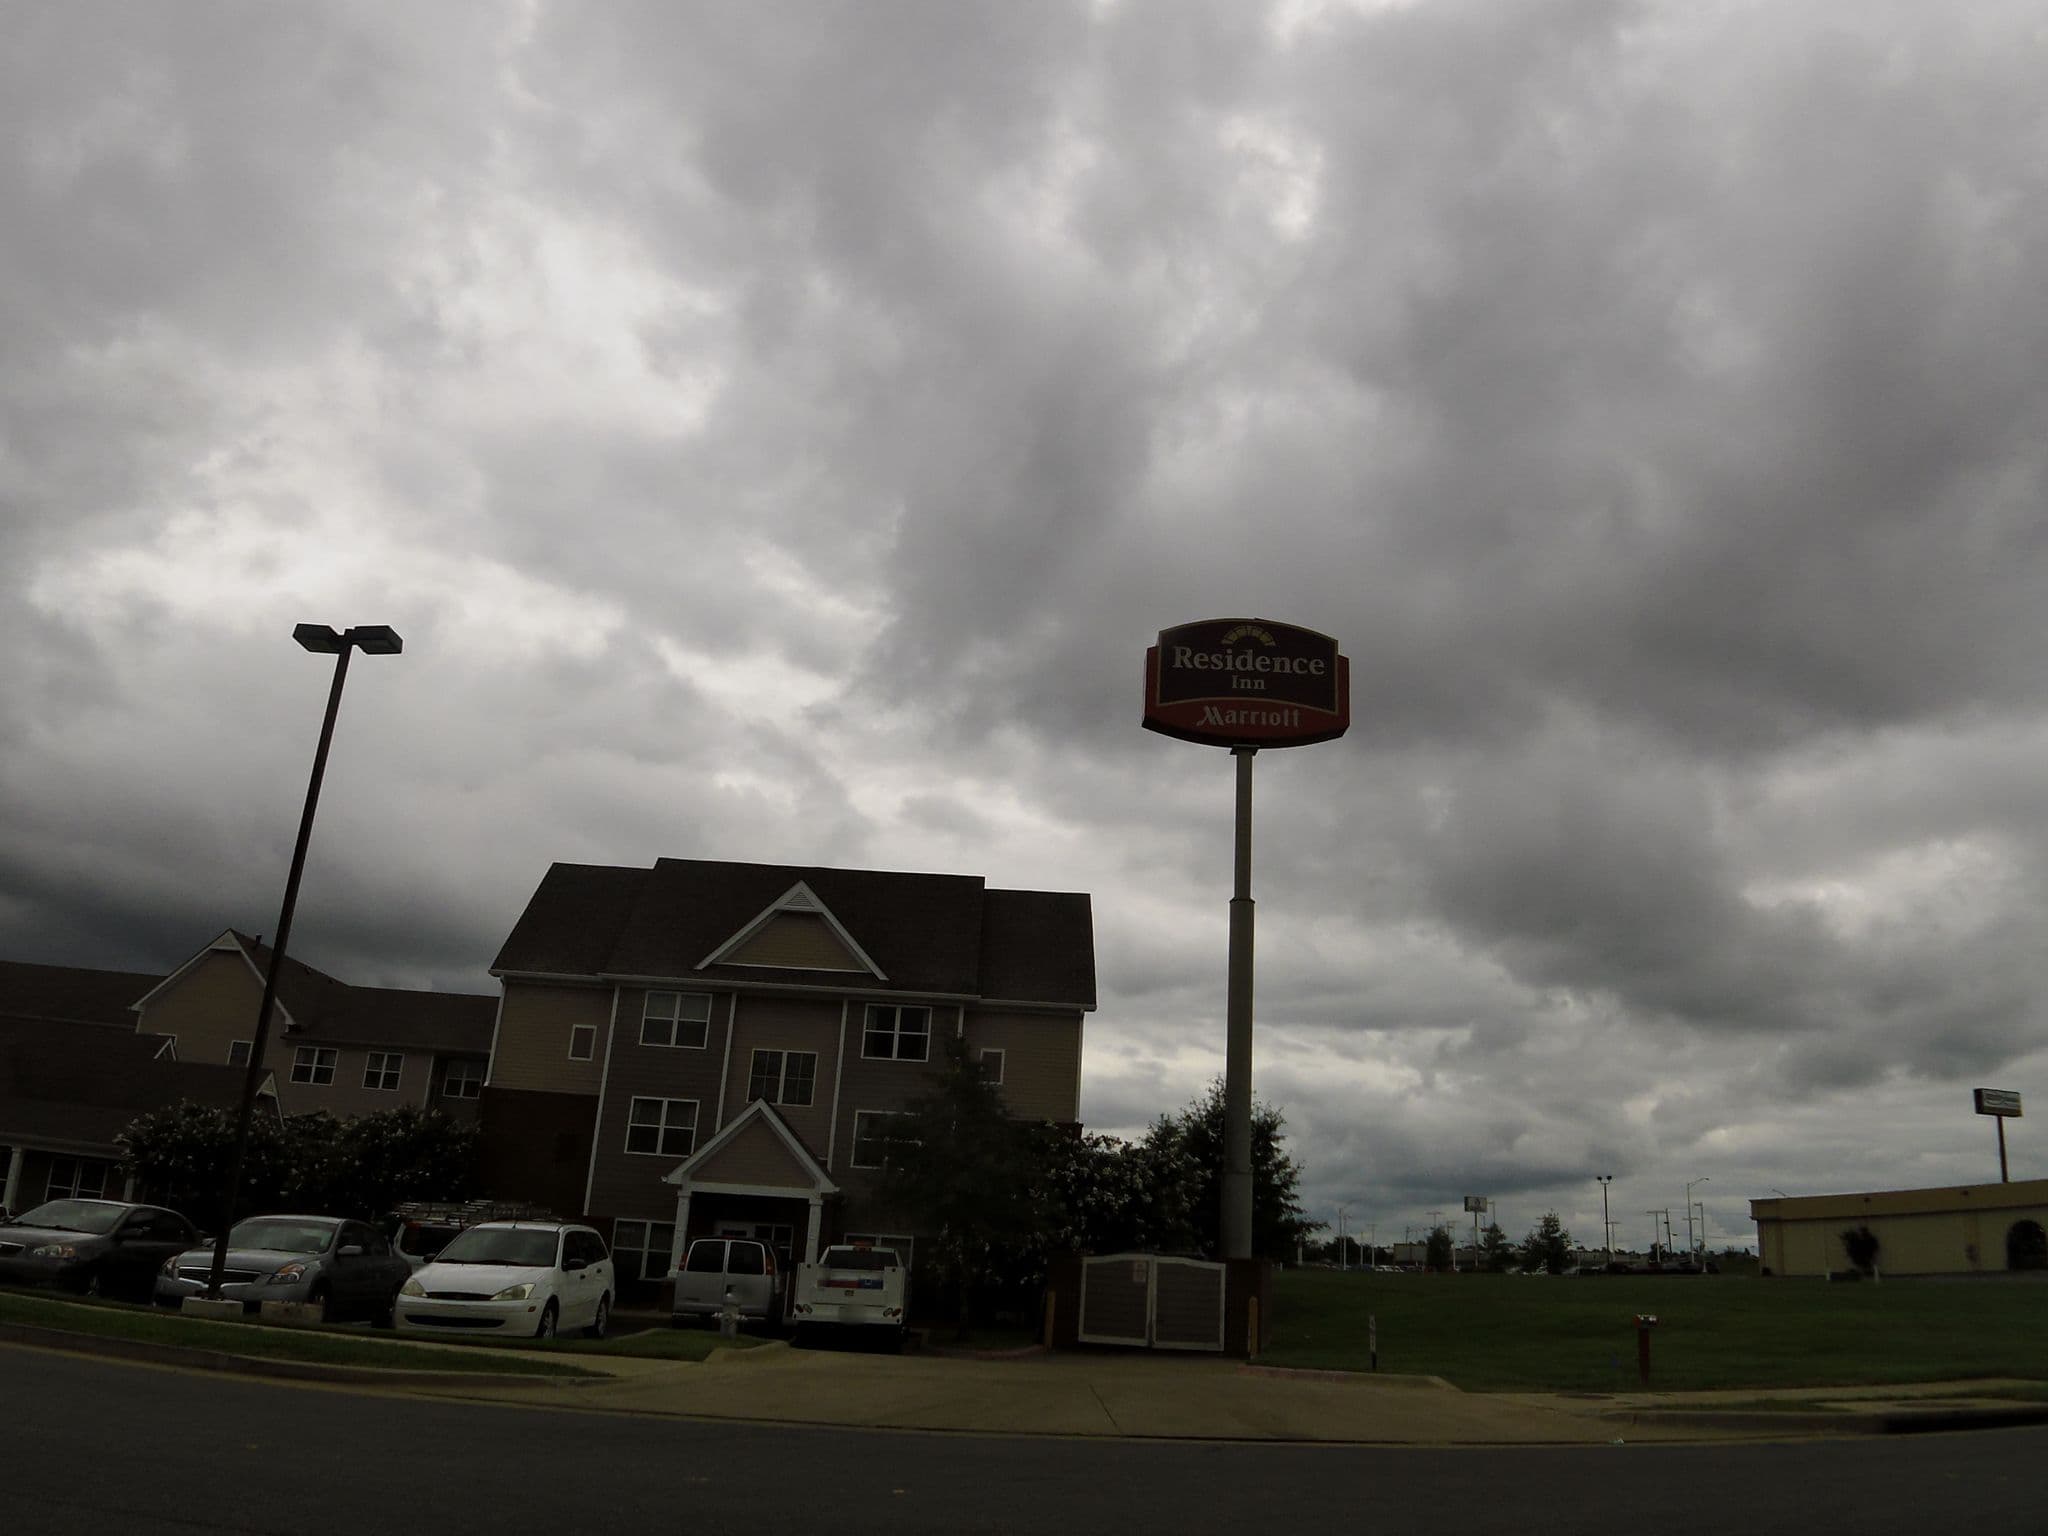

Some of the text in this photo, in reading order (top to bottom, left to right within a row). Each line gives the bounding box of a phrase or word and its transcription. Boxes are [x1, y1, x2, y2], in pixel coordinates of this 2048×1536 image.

[1172, 646, 1326, 675] Residence
[1231, 675, 1266, 690] Inn
[1196, 704, 1302, 727] Marriott
